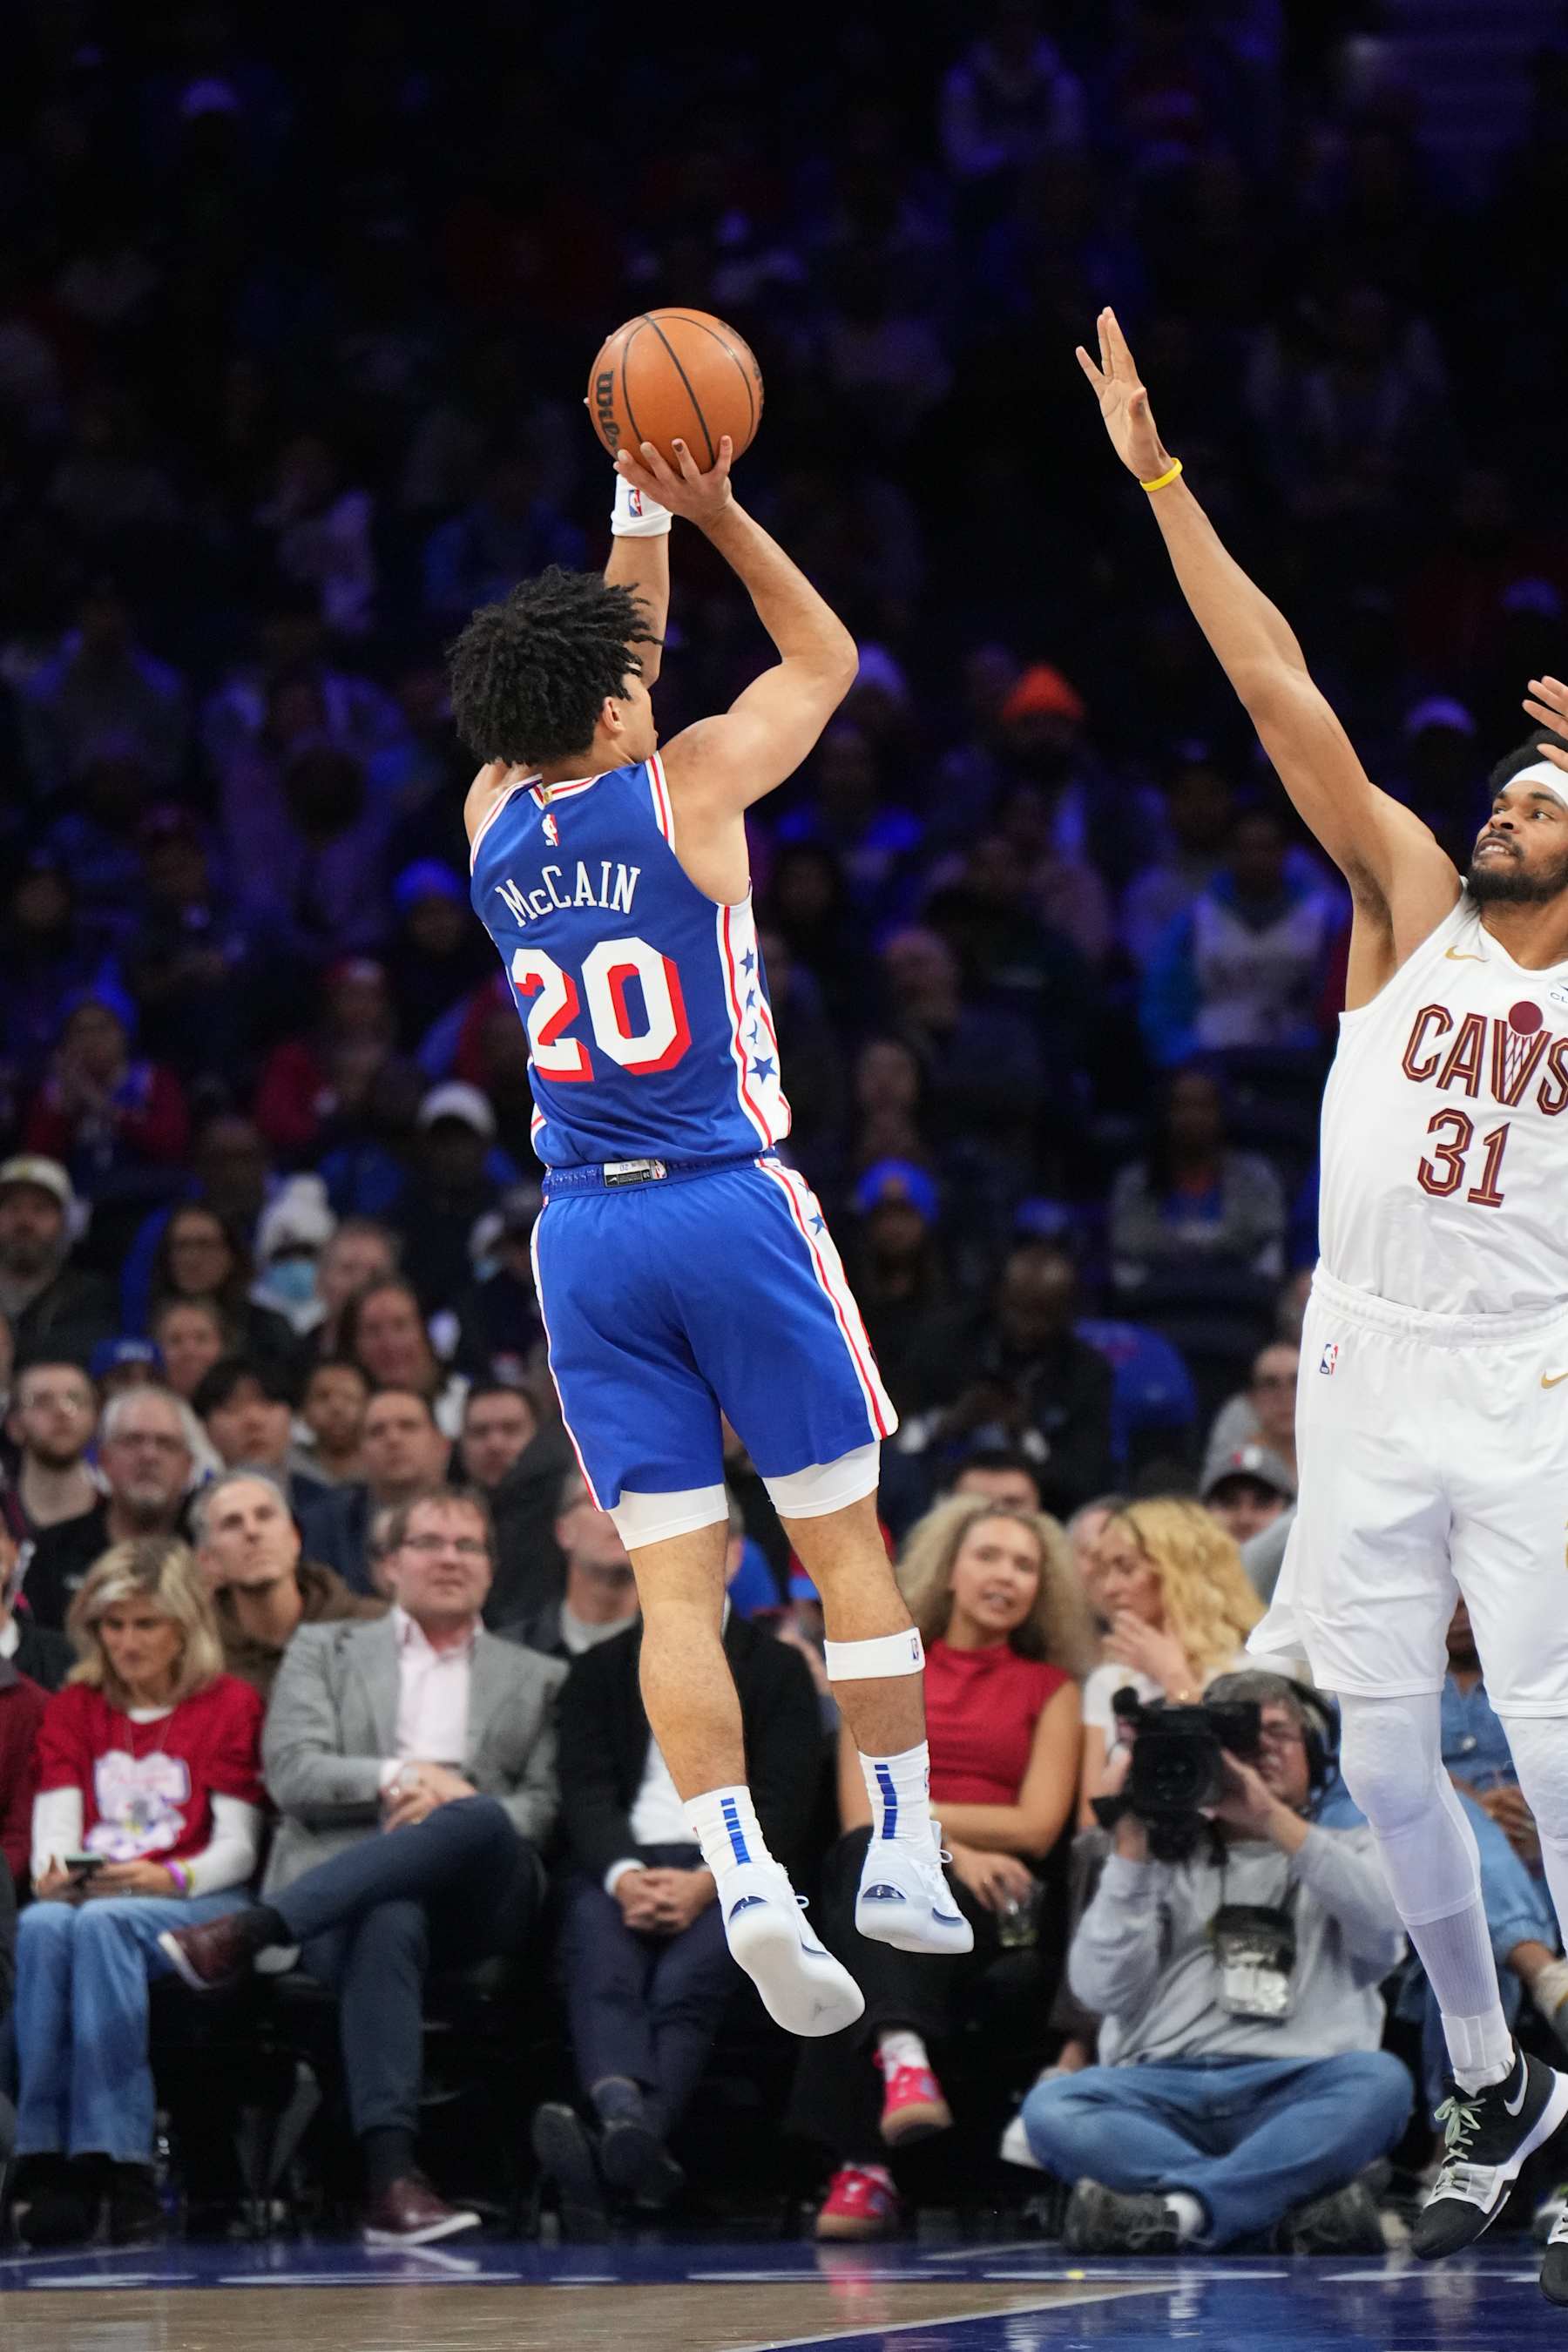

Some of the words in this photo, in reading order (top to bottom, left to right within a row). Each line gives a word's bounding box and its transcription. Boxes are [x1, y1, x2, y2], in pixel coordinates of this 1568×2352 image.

[495, 861, 641, 928] McCAIN
[510, 936, 692, 1082] 20
[1402, 1000, 1568, 1117] CAVS
[1417, 1107, 1511, 1208] 31
